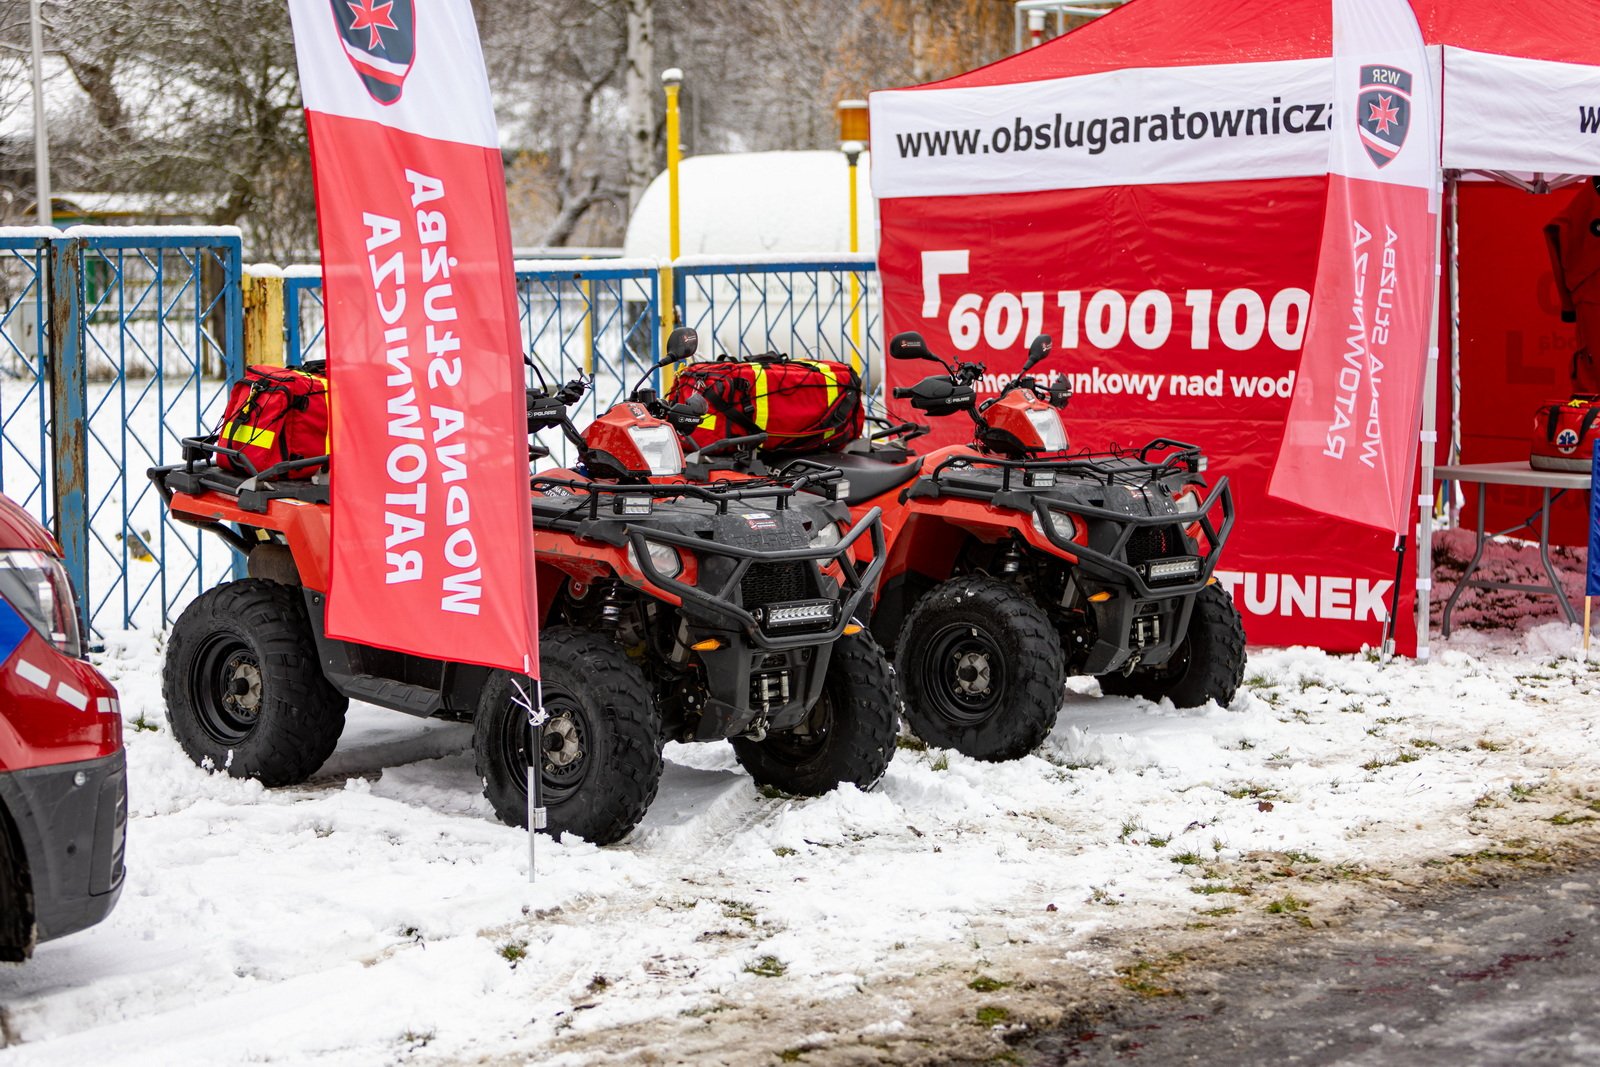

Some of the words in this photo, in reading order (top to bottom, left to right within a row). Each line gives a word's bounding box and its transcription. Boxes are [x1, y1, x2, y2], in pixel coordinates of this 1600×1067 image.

[896, 96, 1333, 158] www.obslugaratownicz
[948, 291, 1044, 351] 601
[1058, 289, 1172, 350] 100
[1185, 287, 1311, 351] 100
[1170, 369, 1223, 397] nad
[533, 409, 557, 417] POLARIS
